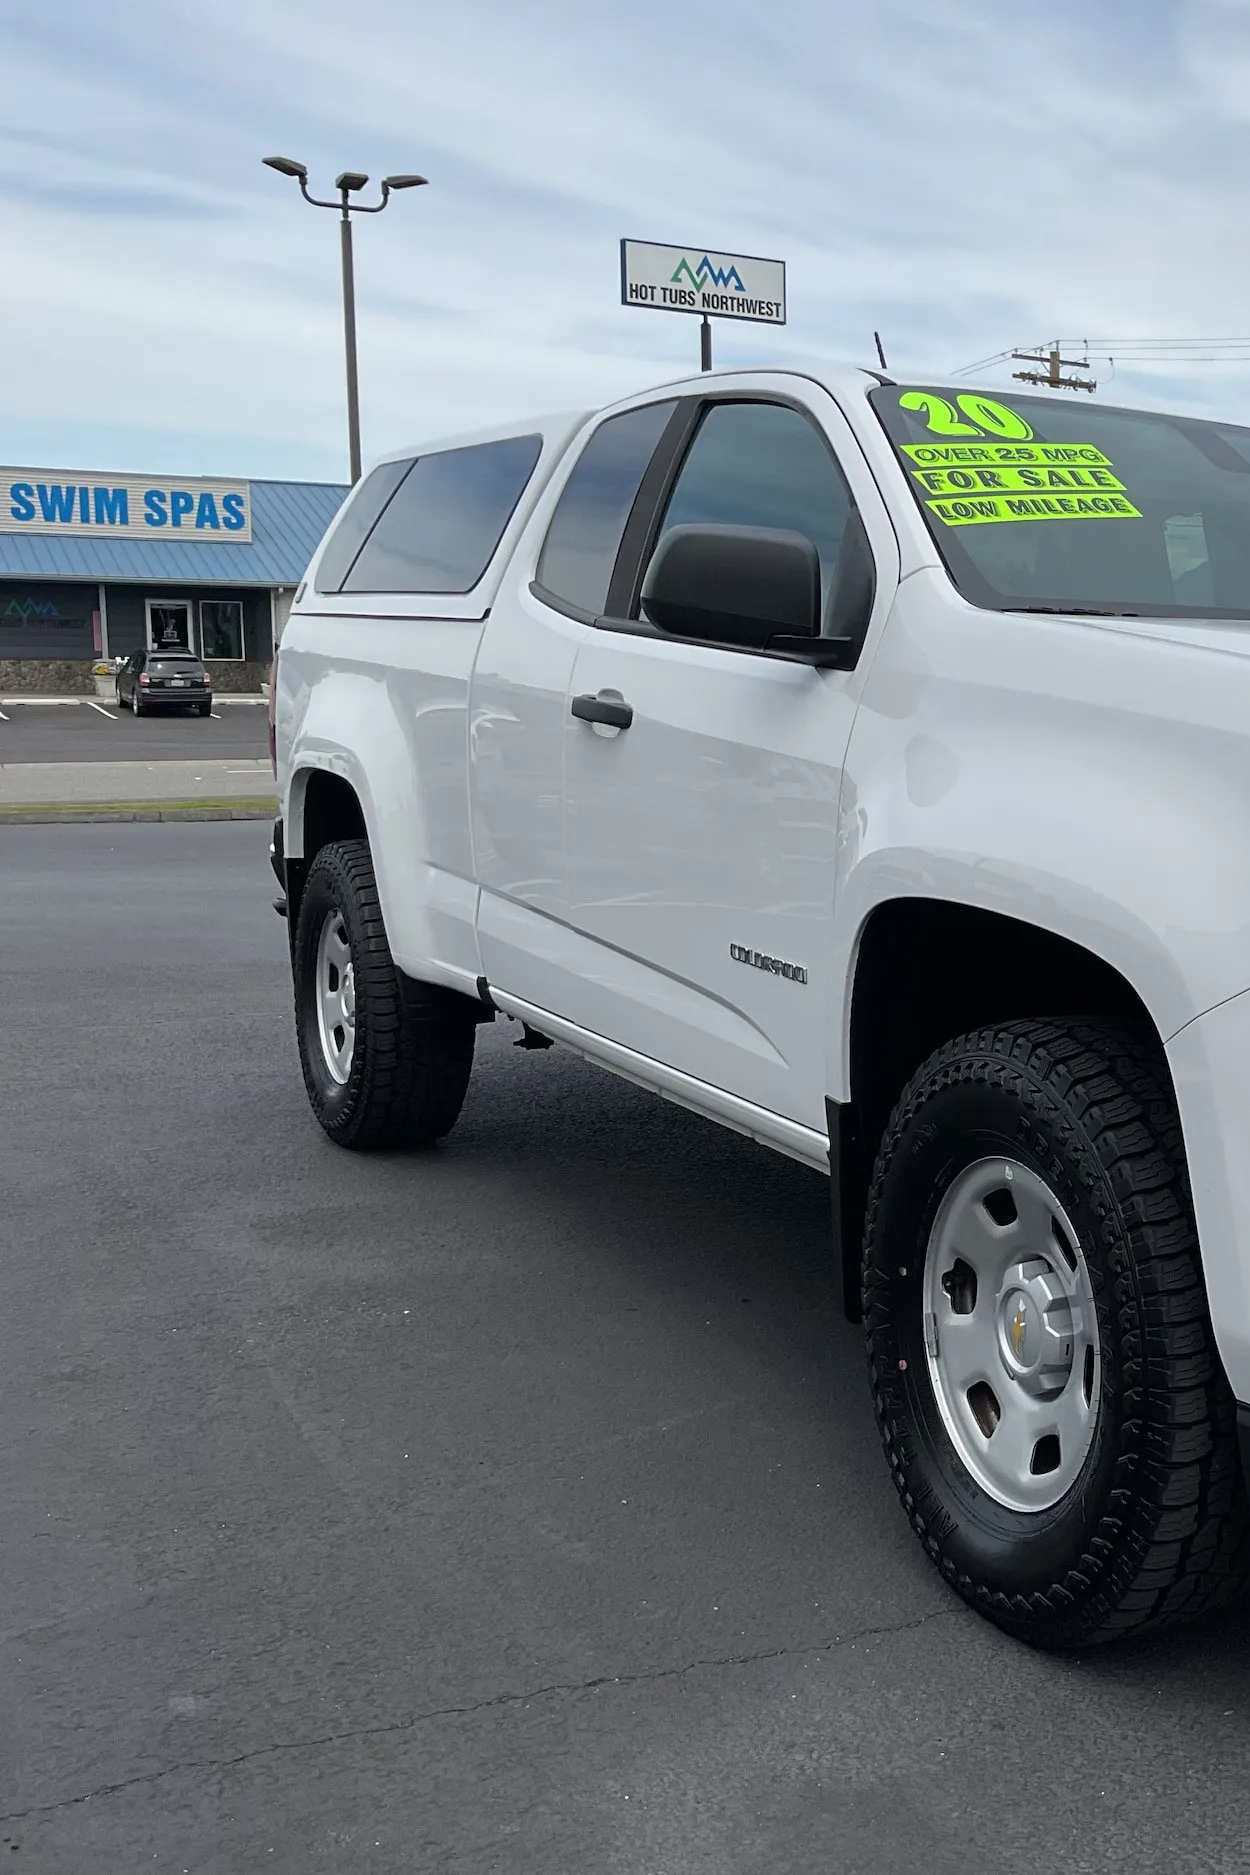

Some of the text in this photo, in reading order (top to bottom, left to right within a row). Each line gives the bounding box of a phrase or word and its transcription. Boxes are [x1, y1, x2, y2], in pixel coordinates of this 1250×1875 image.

[629, 283, 782, 318] HOT TUBS NORTHWEST
[899, 391, 1034, 441] 20
[914, 447, 1105, 463] OVER 25 MPG
[923, 468, 1116, 491] FOR SALE
[10, 482, 246, 531] SWIM SPAS
[934, 497, 1129, 521] LOW MILEAGE
